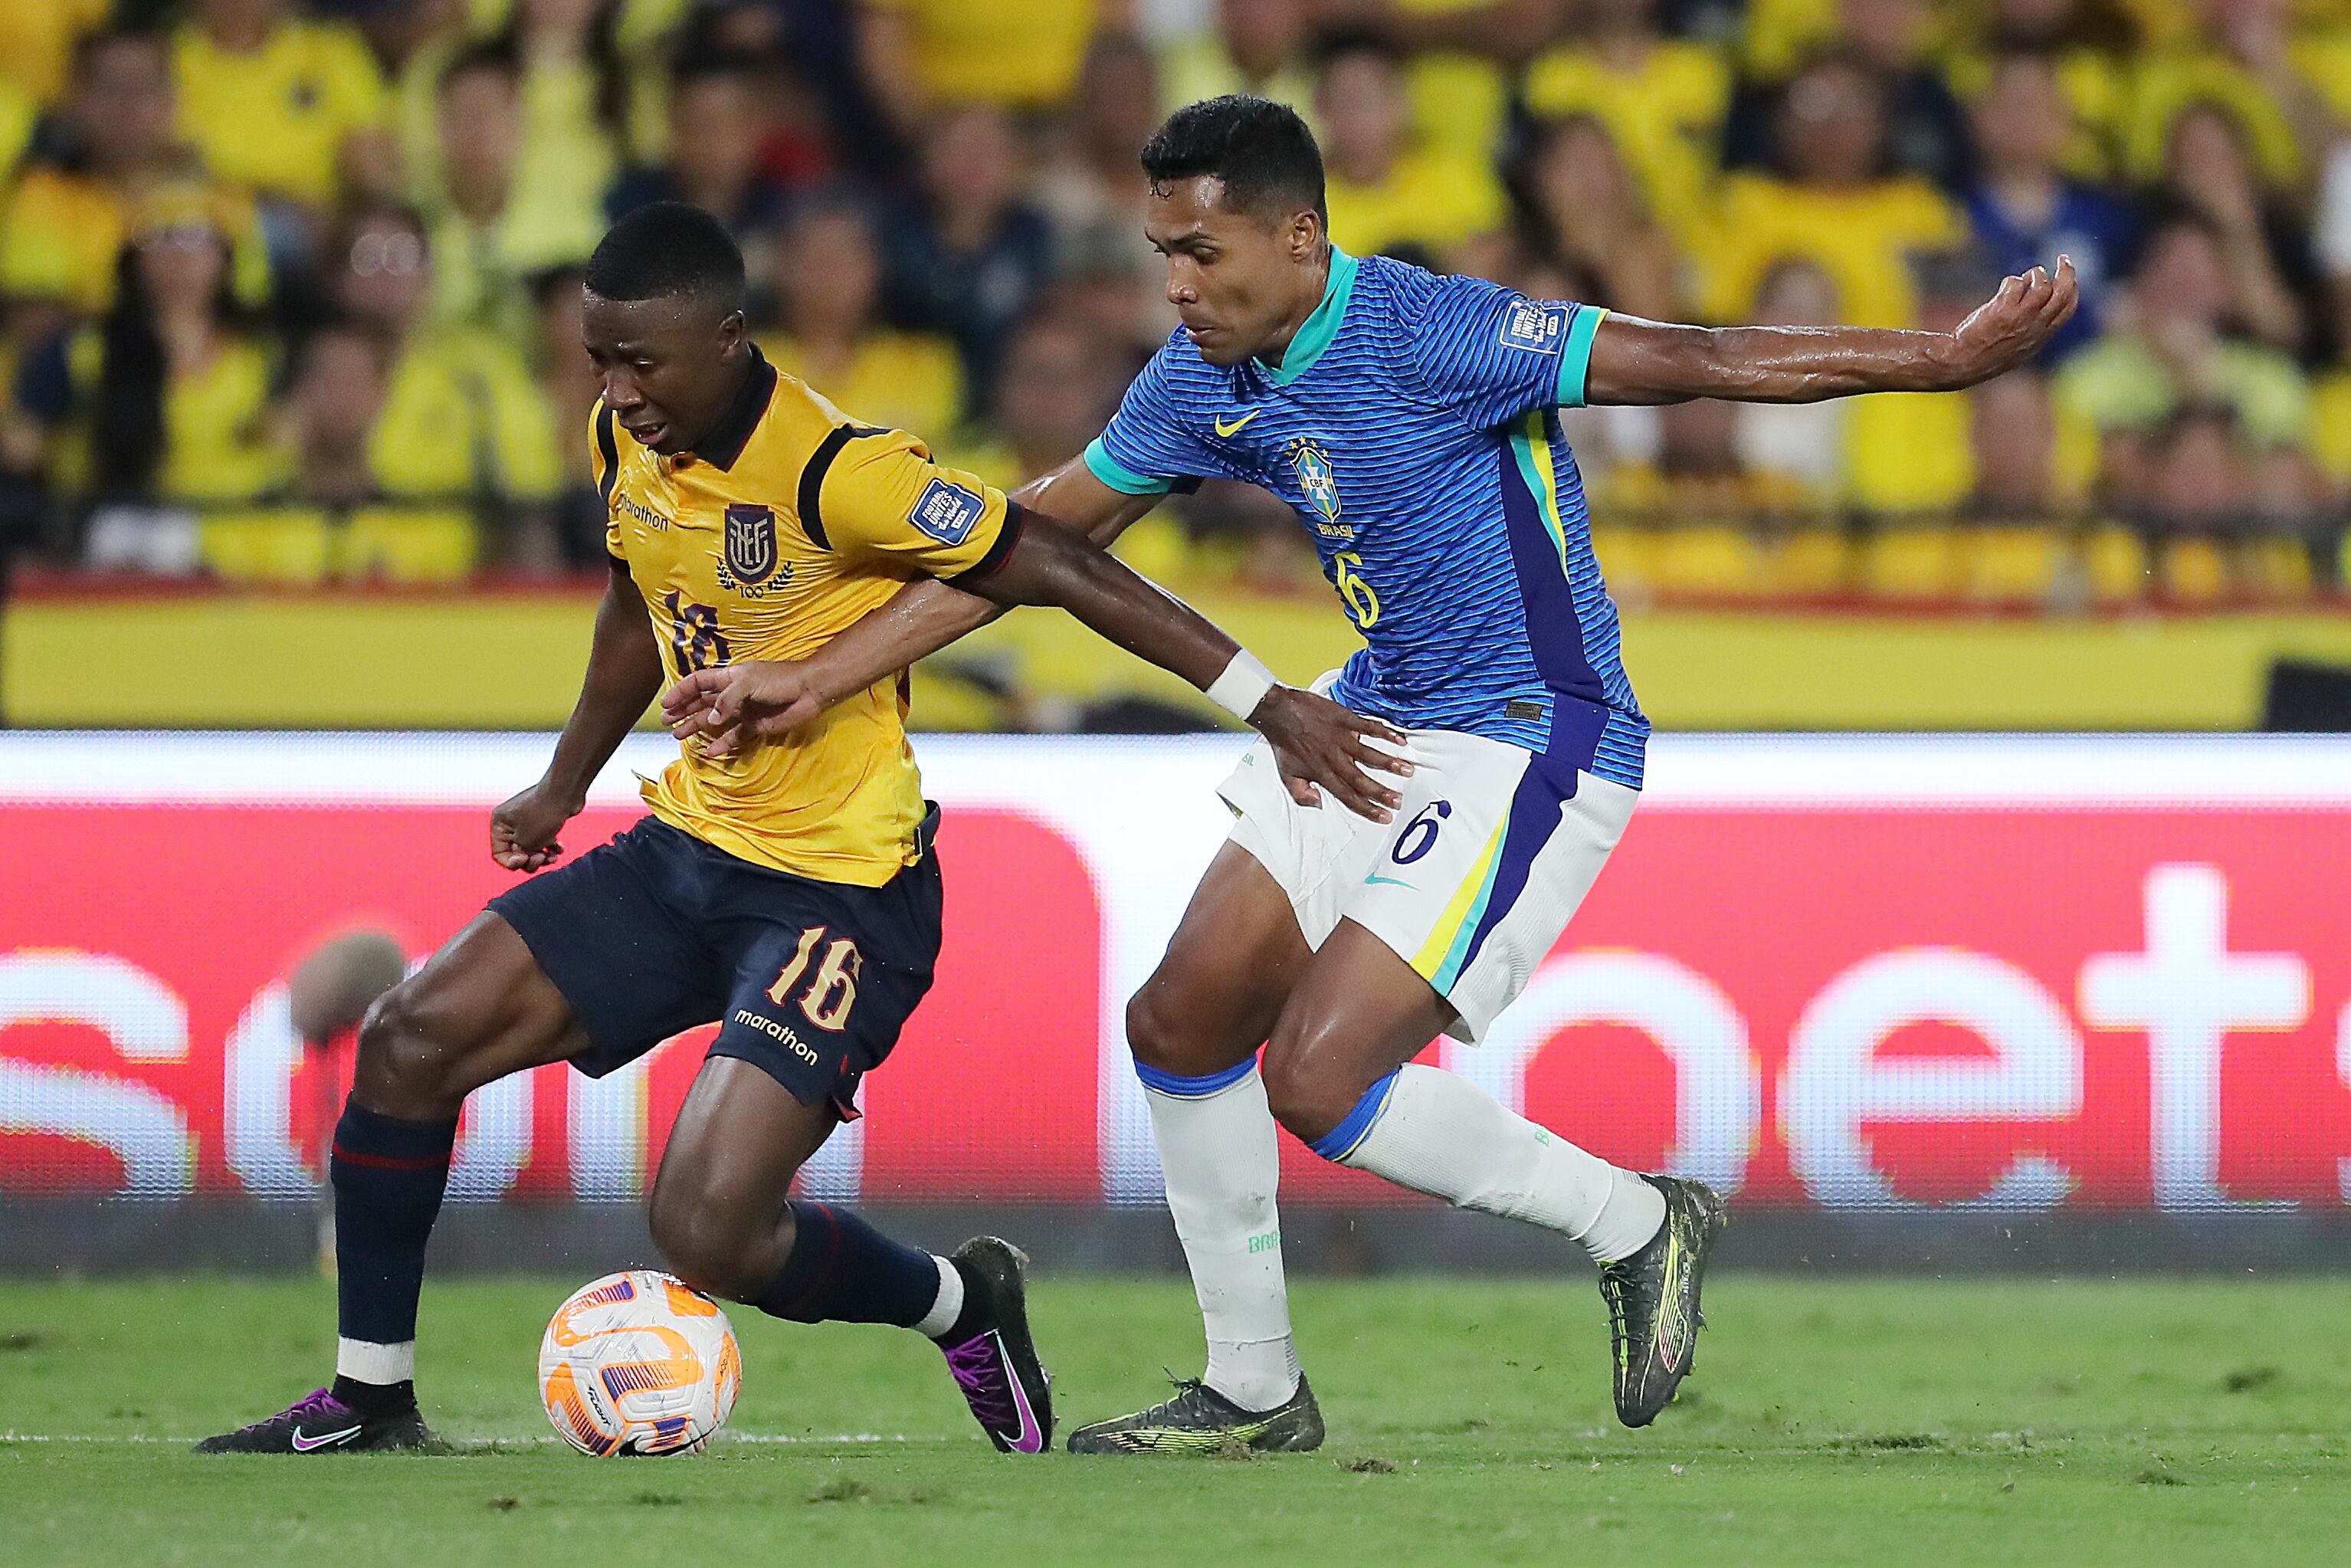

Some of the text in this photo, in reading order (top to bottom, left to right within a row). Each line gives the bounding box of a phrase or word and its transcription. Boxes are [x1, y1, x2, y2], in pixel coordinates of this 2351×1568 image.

[1310, 479, 1323, 487] CBF
[928, 492, 953, 526] UNITES
[943, 496, 963, 520] World
[1317, 523, 1355, 538] BRASIL
[739, 586, 764, 599] 100
[1334, 551, 1379, 628] 6
[1392, 799, 1452, 865] 6
[765, 924, 864, 1032] 16
[733, 1009, 819, 1066] marathon
[1439, 858, 2351, 1213] bet
